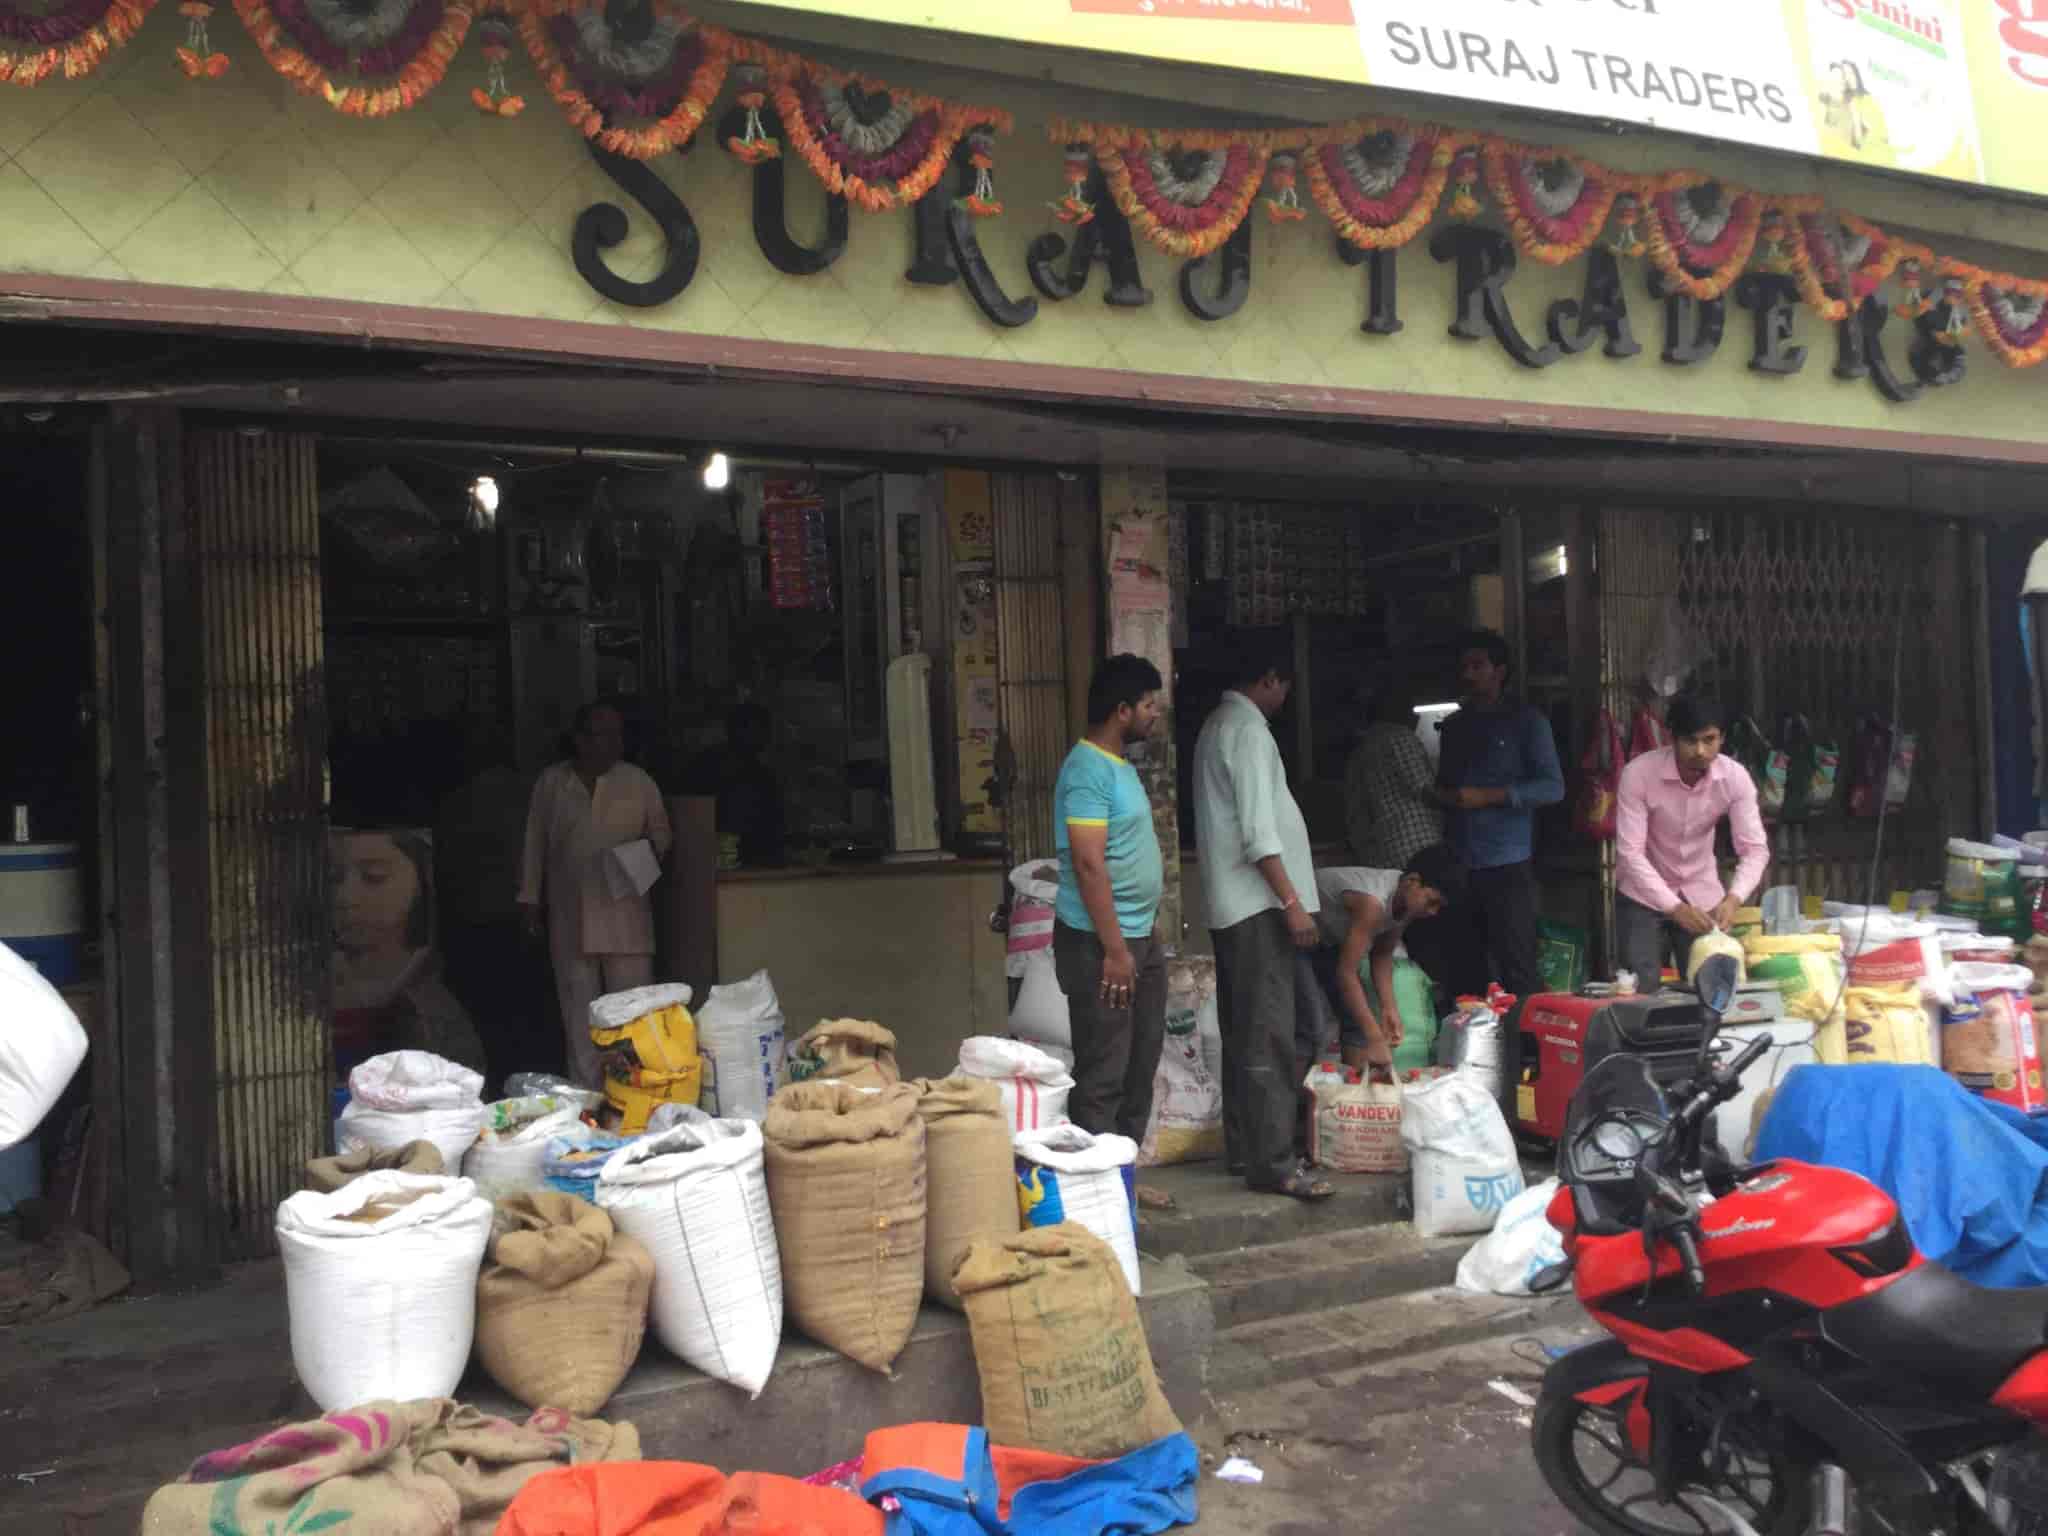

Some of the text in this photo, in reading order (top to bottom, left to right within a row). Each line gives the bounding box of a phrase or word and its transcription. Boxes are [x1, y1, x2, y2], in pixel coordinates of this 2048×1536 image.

[1823, 0, 1943, 43] mini
[1385, 20, 1793, 124] SURAJ TRADERS
